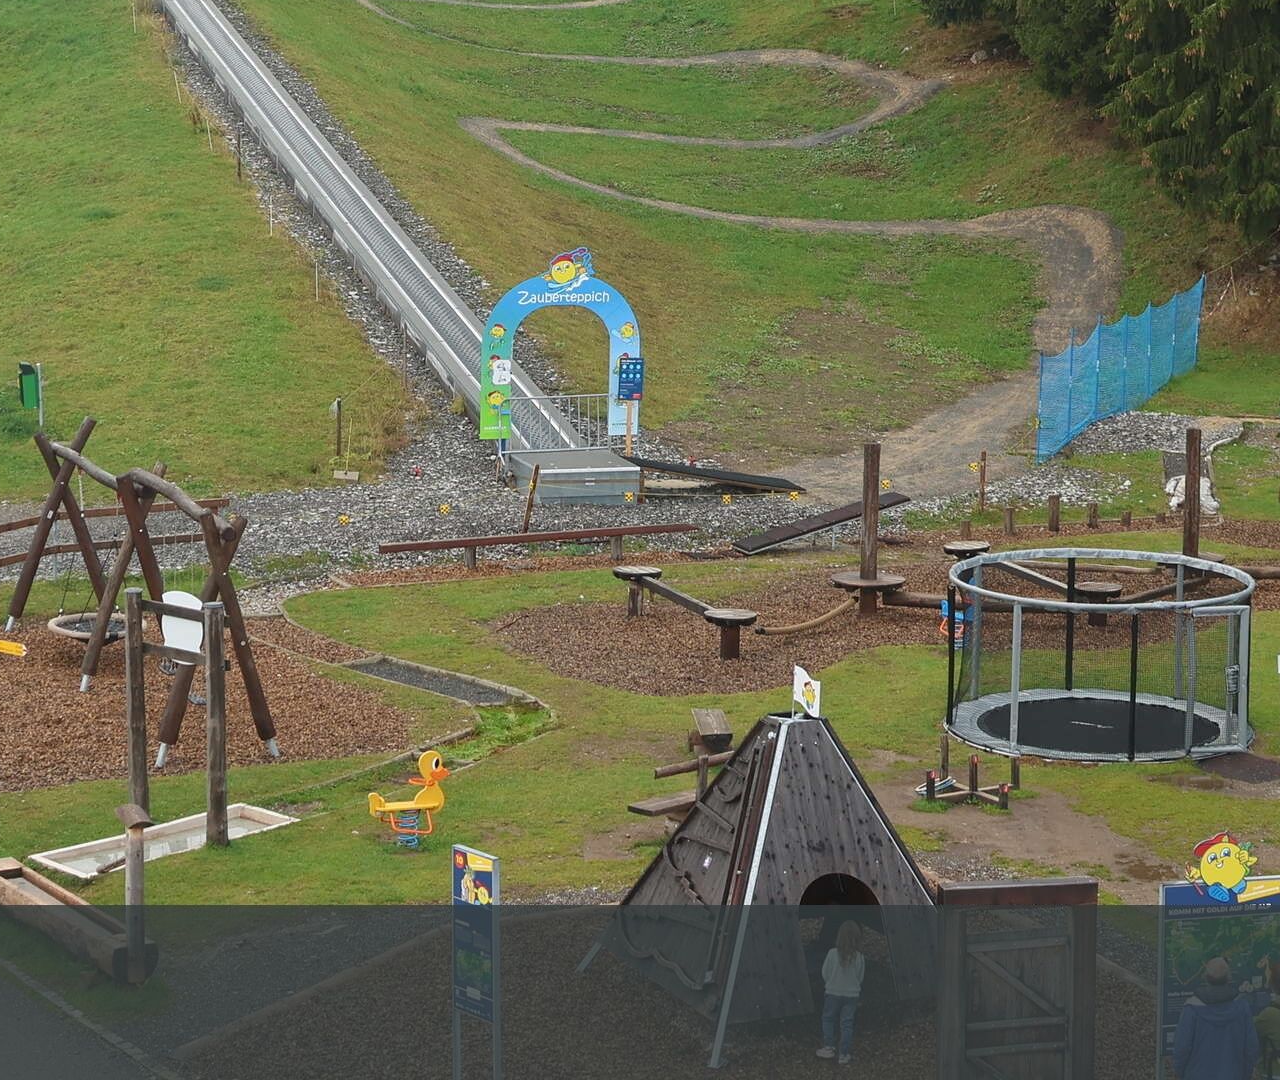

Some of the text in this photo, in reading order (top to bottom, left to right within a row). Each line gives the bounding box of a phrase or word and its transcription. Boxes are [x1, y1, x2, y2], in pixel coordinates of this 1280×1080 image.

[517, 290, 610, 305] Zauberteppich
[1168, 908, 1191, 916] KOMM
[1206, 906, 1228, 914] GOLDI
[1257, 903, 1272, 911] ALP
